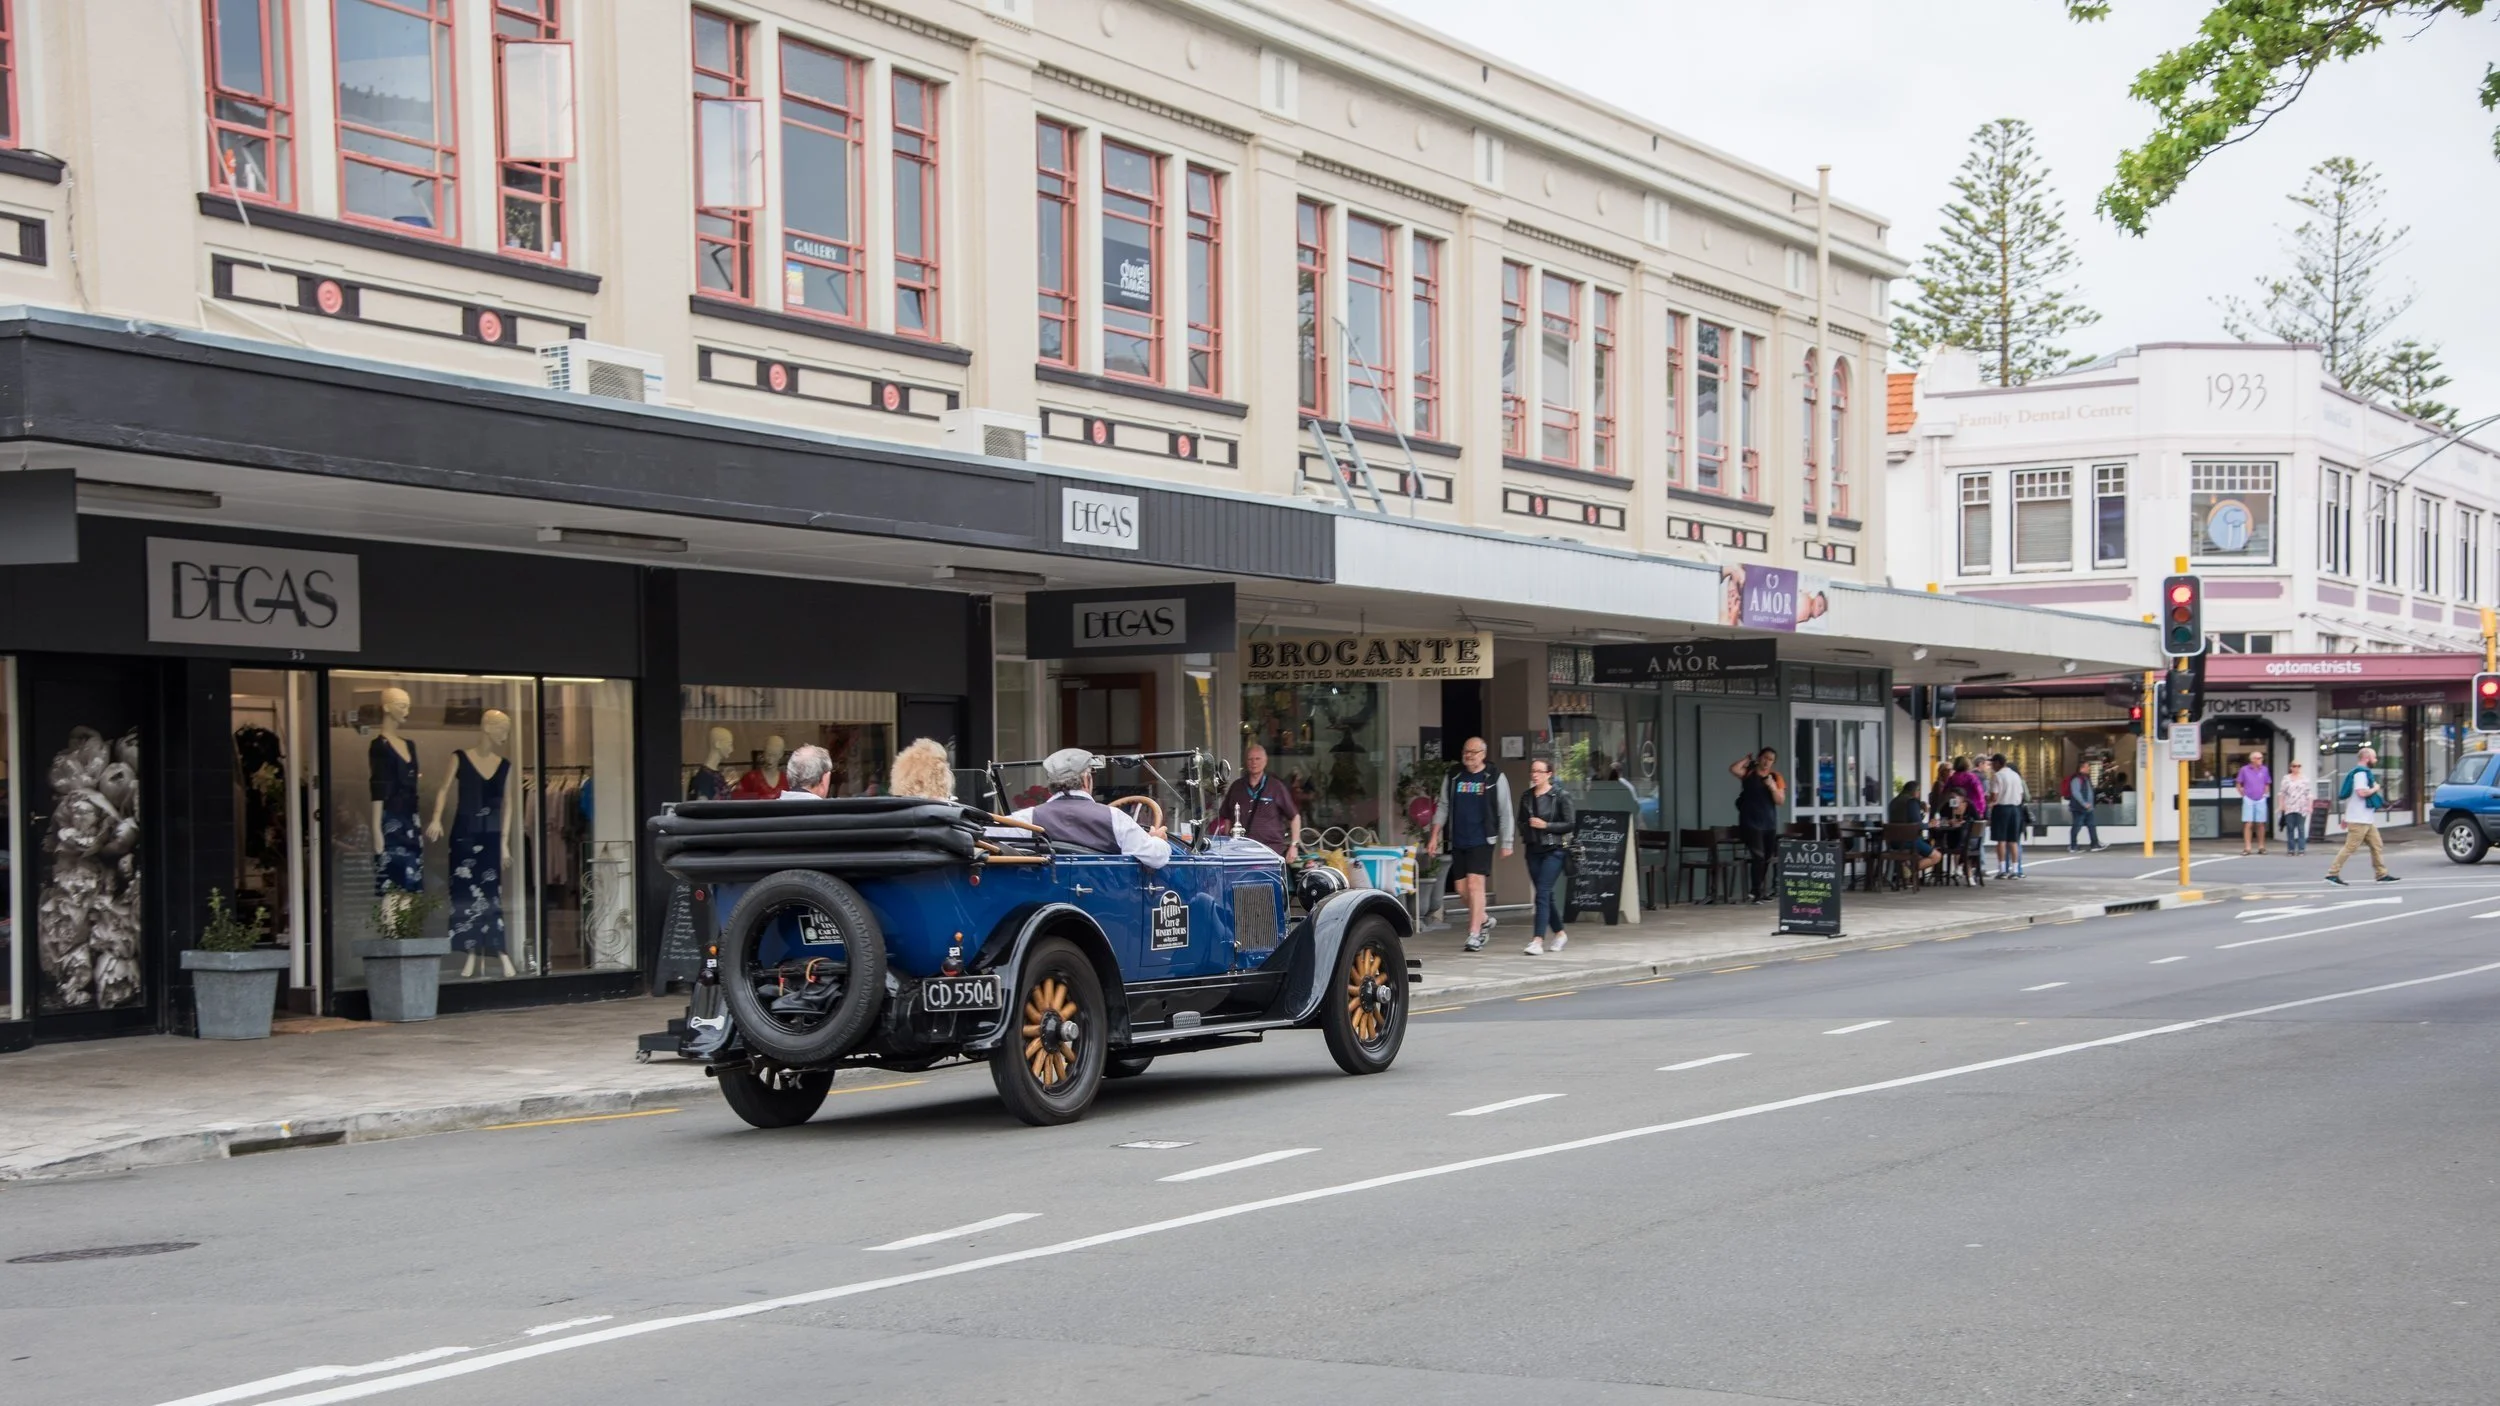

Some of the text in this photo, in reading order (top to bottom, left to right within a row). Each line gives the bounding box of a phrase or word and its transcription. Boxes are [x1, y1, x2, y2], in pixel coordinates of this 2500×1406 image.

[793, 239, 838, 260] GALLERY
[2206, 373, 2268, 411] 1933
[1958, 403, 2134, 429] Family Dental Centre
[1072, 500, 1133, 538] DEGAS
[172, 561, 338, 628] DEGAS
[1749, 586, 1792, 615] AMOR
[1084, 606, 1174, 639] DEGAS
[1248, 637, 1481, 668] BROCANTE
[1647, 655, 1720, 673] AMOR
[1248, 666, 1481, 681] FRENCH STYLED HOMEWARES & JEWELLERY
[2266, 660, 2362, 676] optometrists
[2202, 698, 2292, 713] TOMETRISTS
[1783, 851, 1836, 865] AMOR
[1811, 871, 1835, 879] OPEN
[928, 981, 994, 1006] CD 5504
